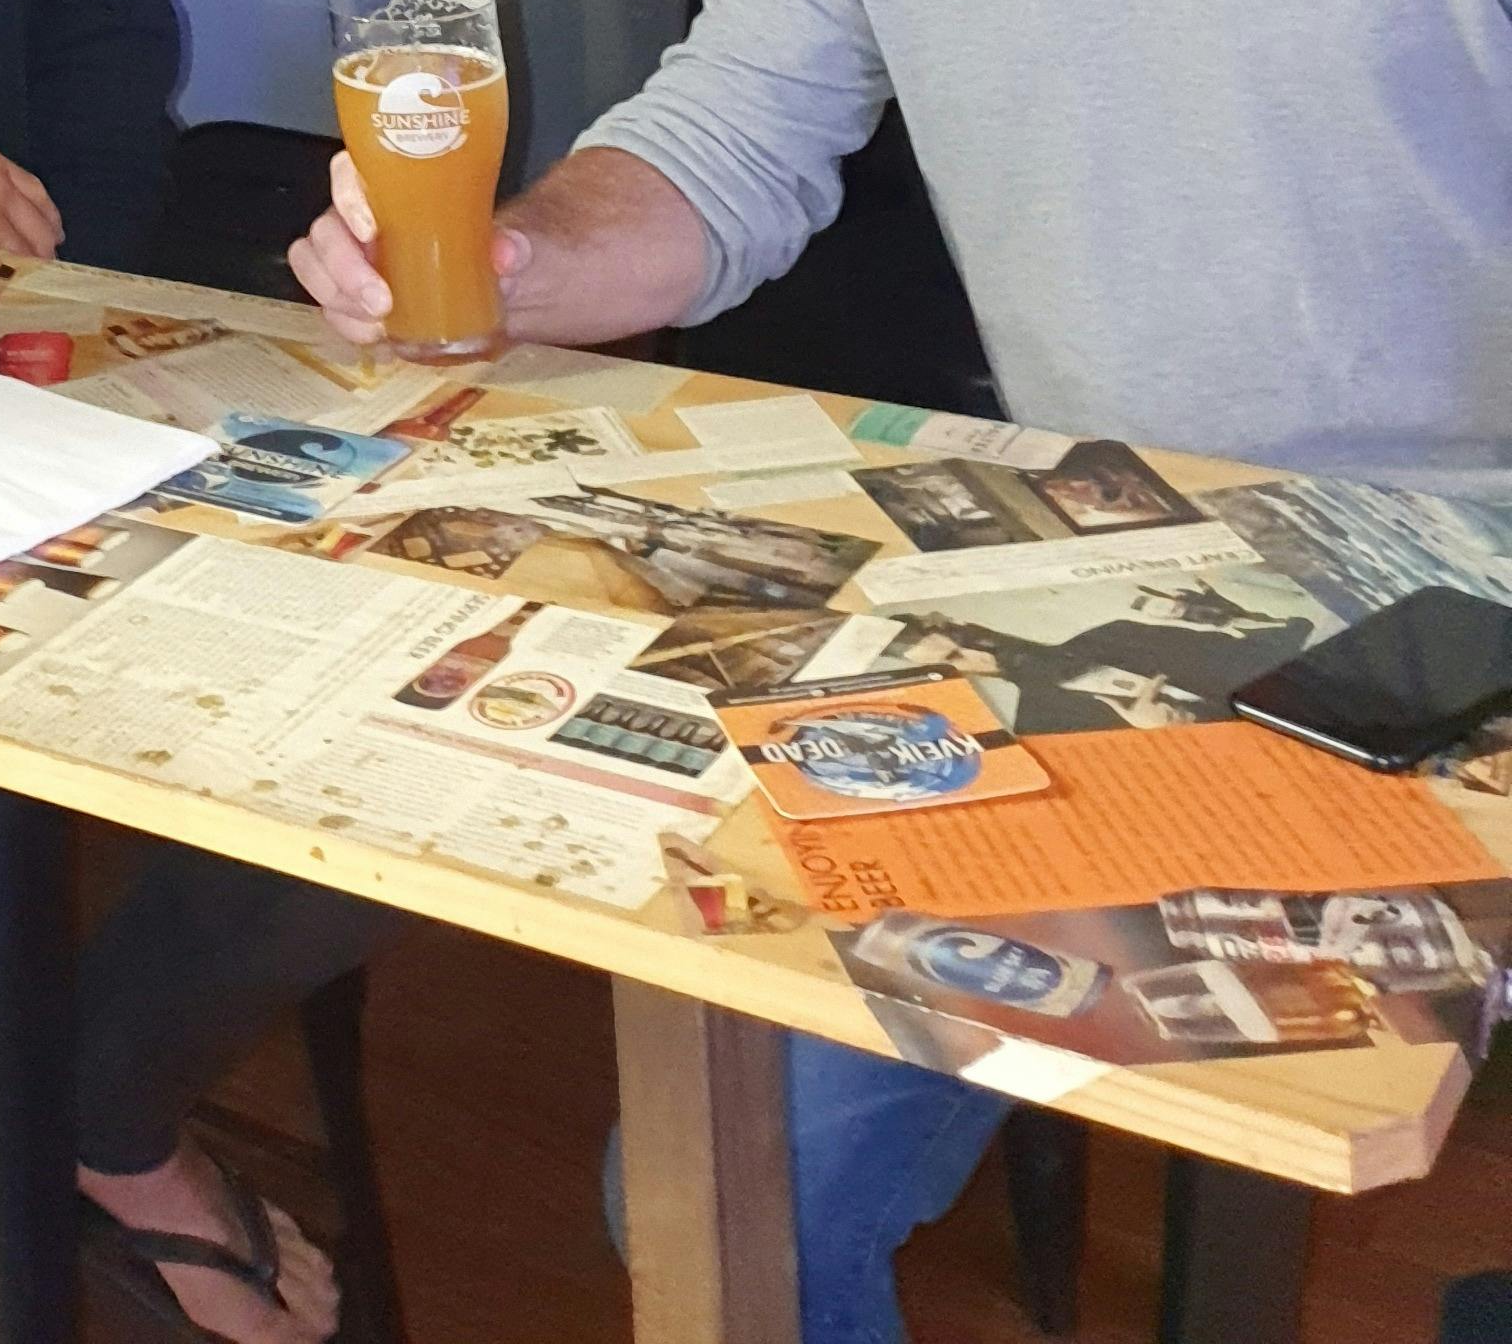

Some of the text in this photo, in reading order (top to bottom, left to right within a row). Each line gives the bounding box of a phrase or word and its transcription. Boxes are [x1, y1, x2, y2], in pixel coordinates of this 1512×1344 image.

[371, 108, 470, 130] SUNSHINE
[760, 733, 984, 766] KVEIK DEAD
[849, 859, 906, 909] BEER
